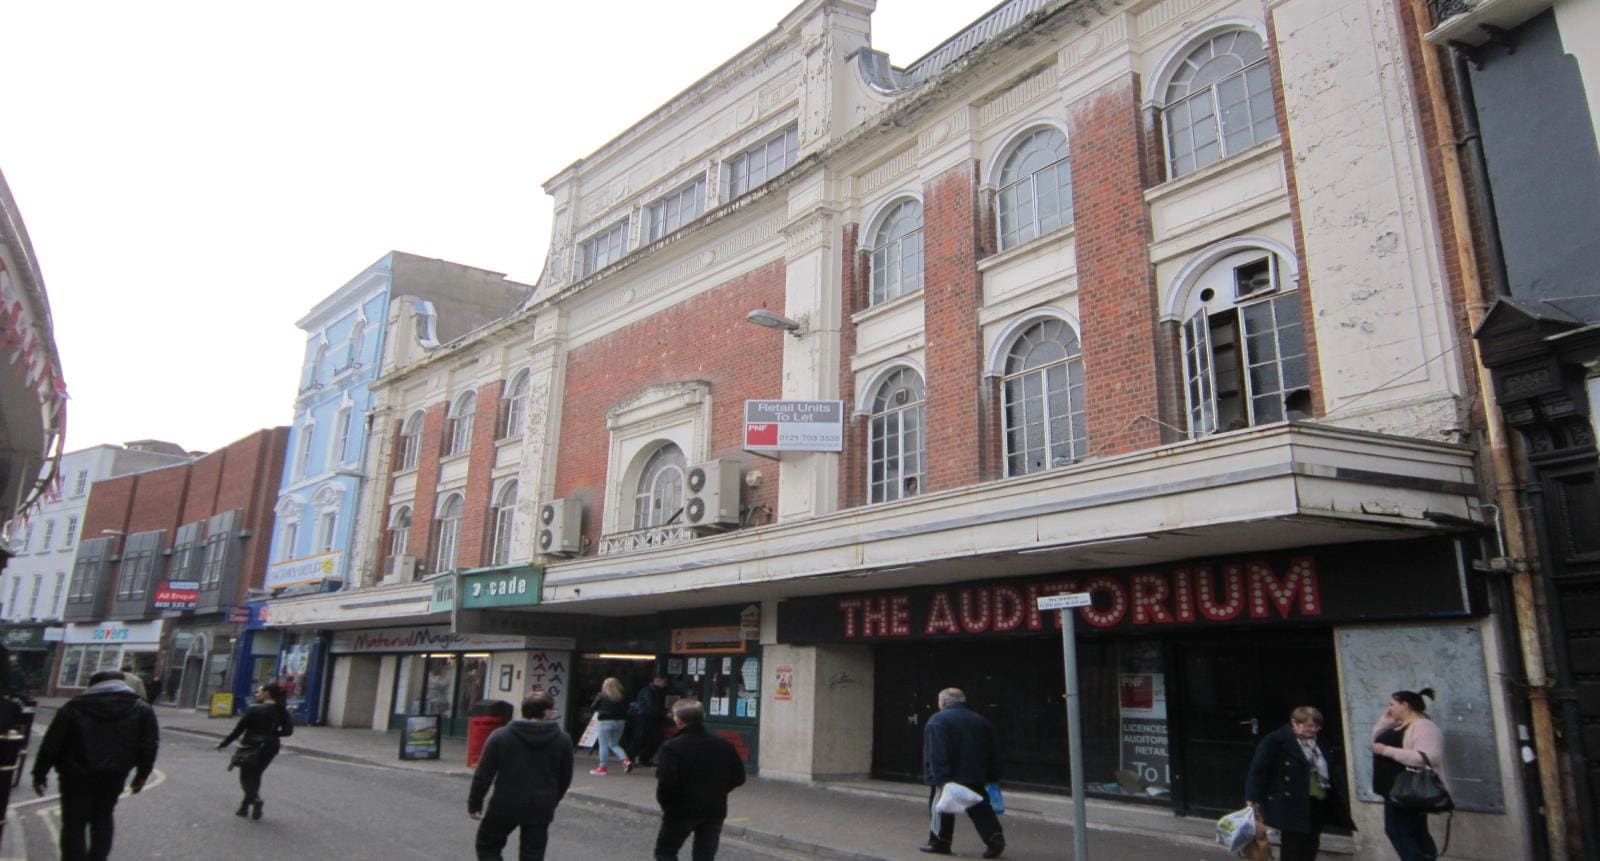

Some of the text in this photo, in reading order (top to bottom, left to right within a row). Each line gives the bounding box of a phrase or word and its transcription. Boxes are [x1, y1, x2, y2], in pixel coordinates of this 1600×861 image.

[758, 403, 831, 413] Retail Units
[774, 412, 814, 422] To Let
[748, 424, 768, 432] PNF
[838, 556, 1322, 638] THE AUDITORIUM
[354, 632, 416, 651] Material
[415, 629, 464, 649] Magic
[1131, 761, 1158, 782] To
